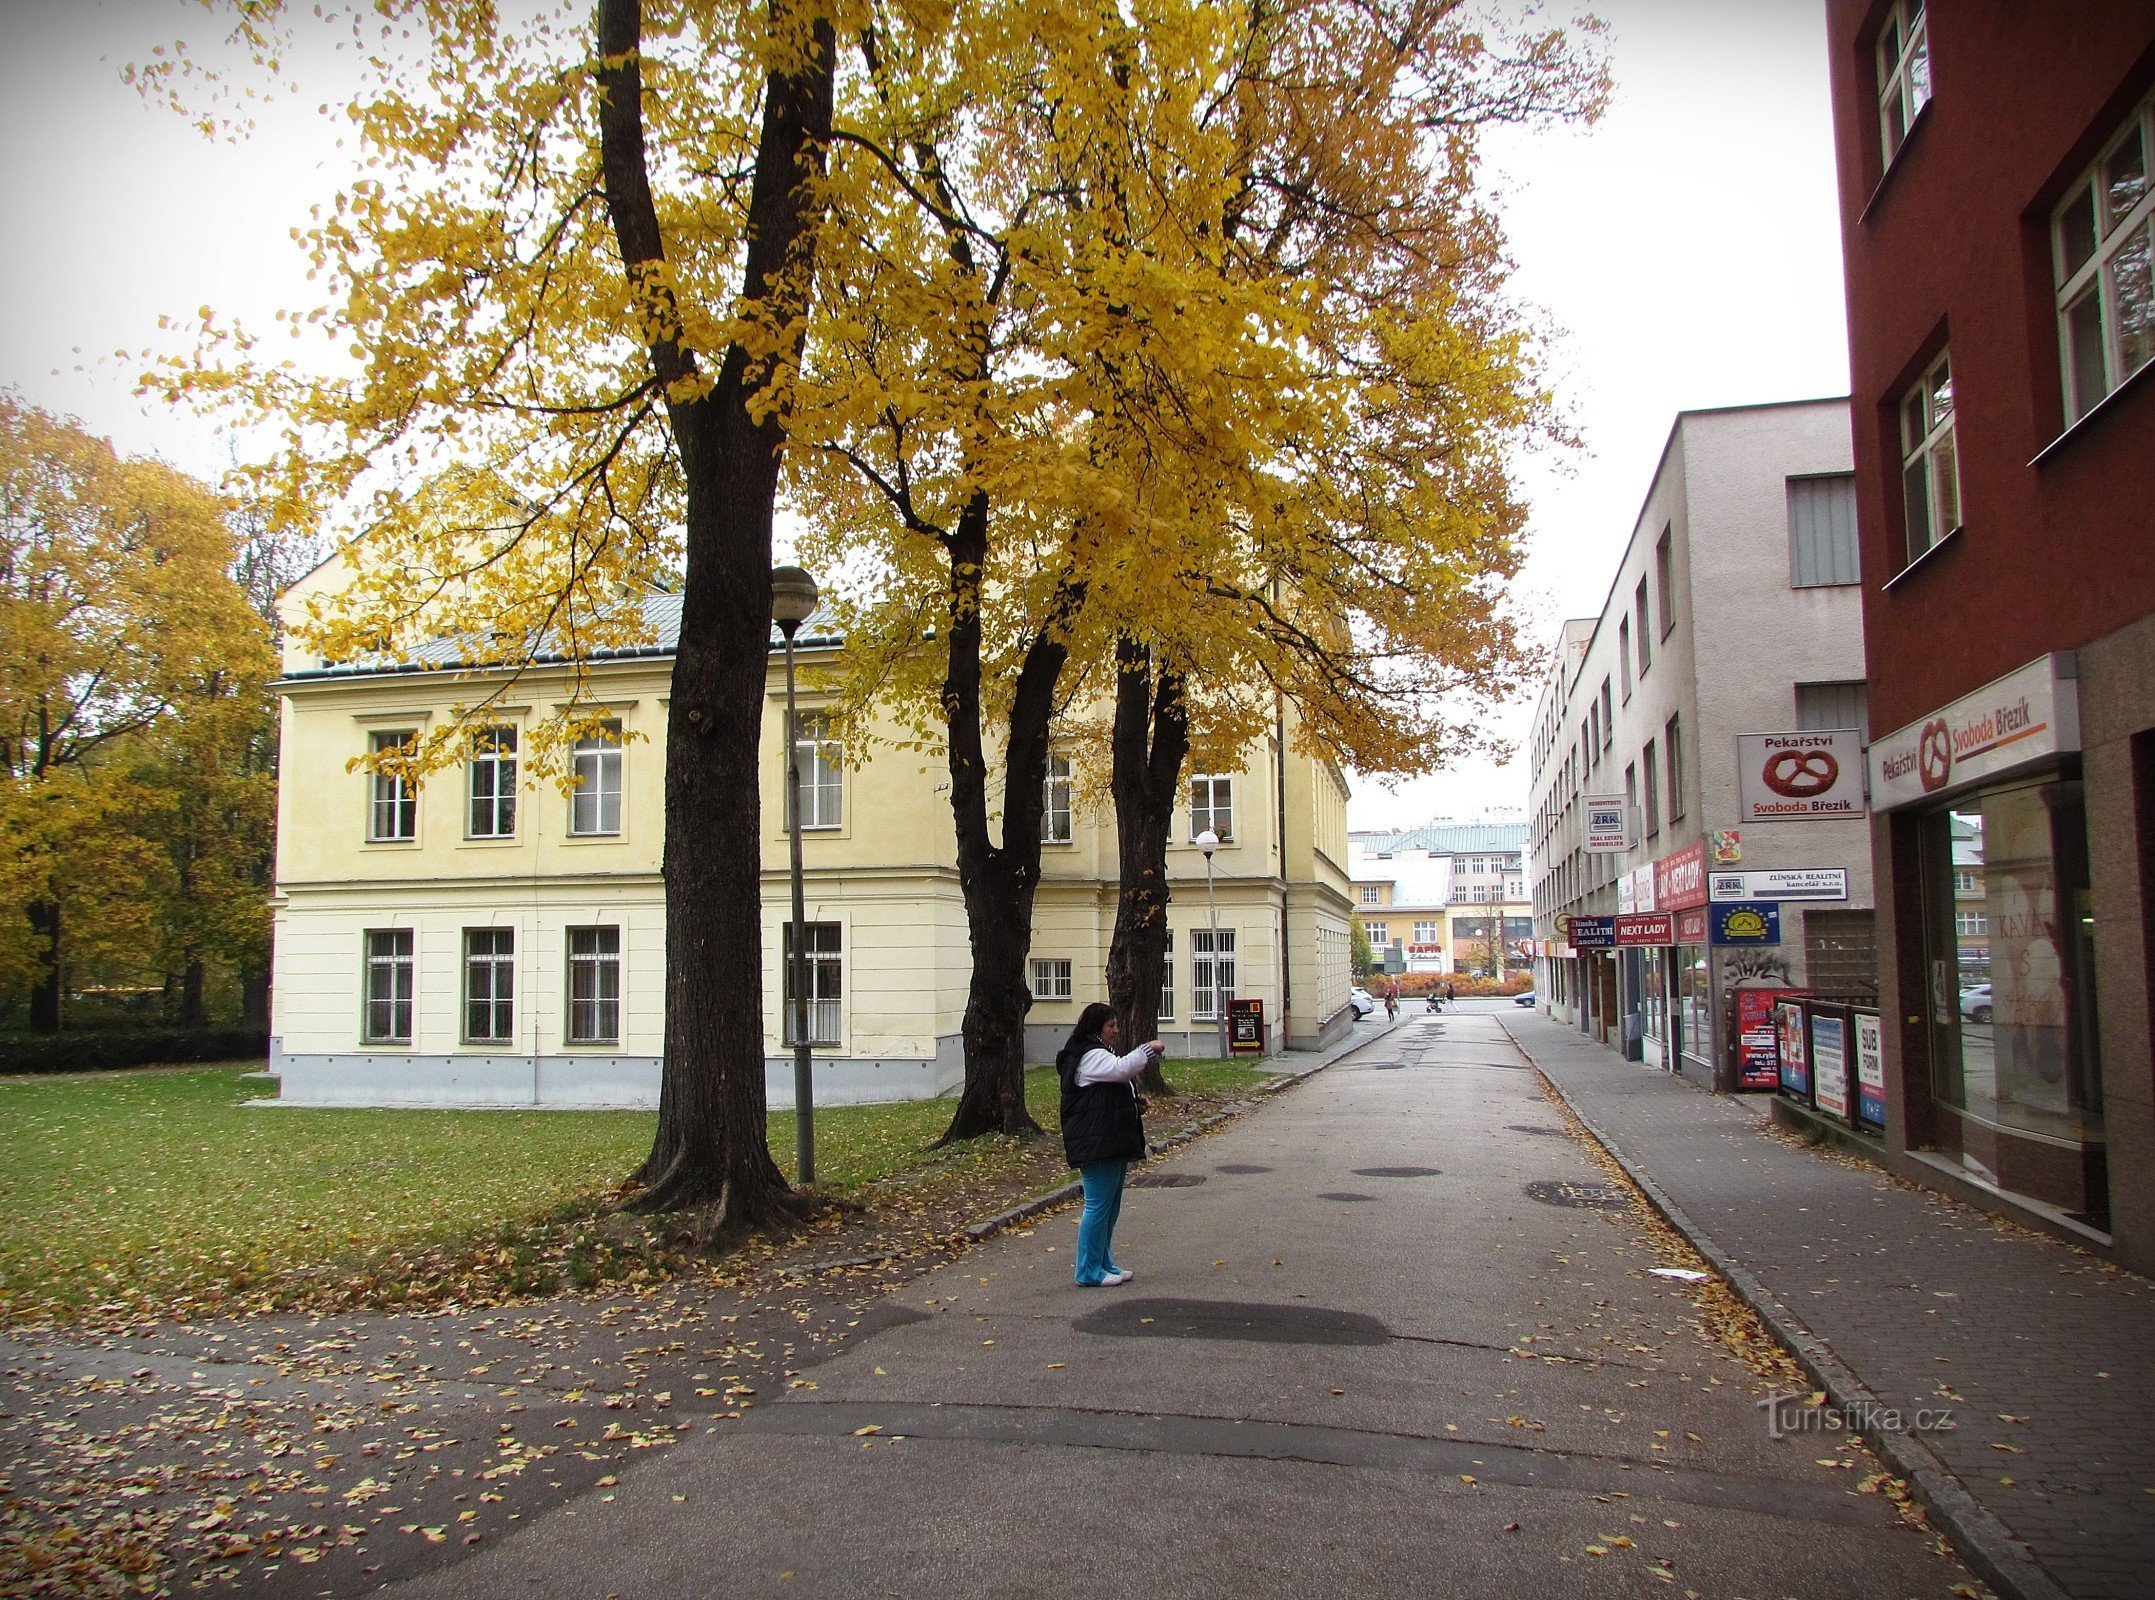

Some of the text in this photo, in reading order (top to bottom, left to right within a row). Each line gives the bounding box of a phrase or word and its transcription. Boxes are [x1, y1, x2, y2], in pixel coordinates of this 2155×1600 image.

[1952, 695, 2031, 753] Svoboda Březík
[1765, 736, 1833, 748] Pekařství
[1882, 747, 1917, 782] Pekařství
[1753, 800, 1852, 813] Svoboda Březík
[1593, 815, 1618, 825] ZRK
[1769, 872, 1841, 881] ZLÍNSKÁ REALITNÍ
[1718, 881, 1743, 890] ZRK
[1786, 880, 1819, 888] kancelář
[1620, 924, 1667, 936] NEXT LADY
